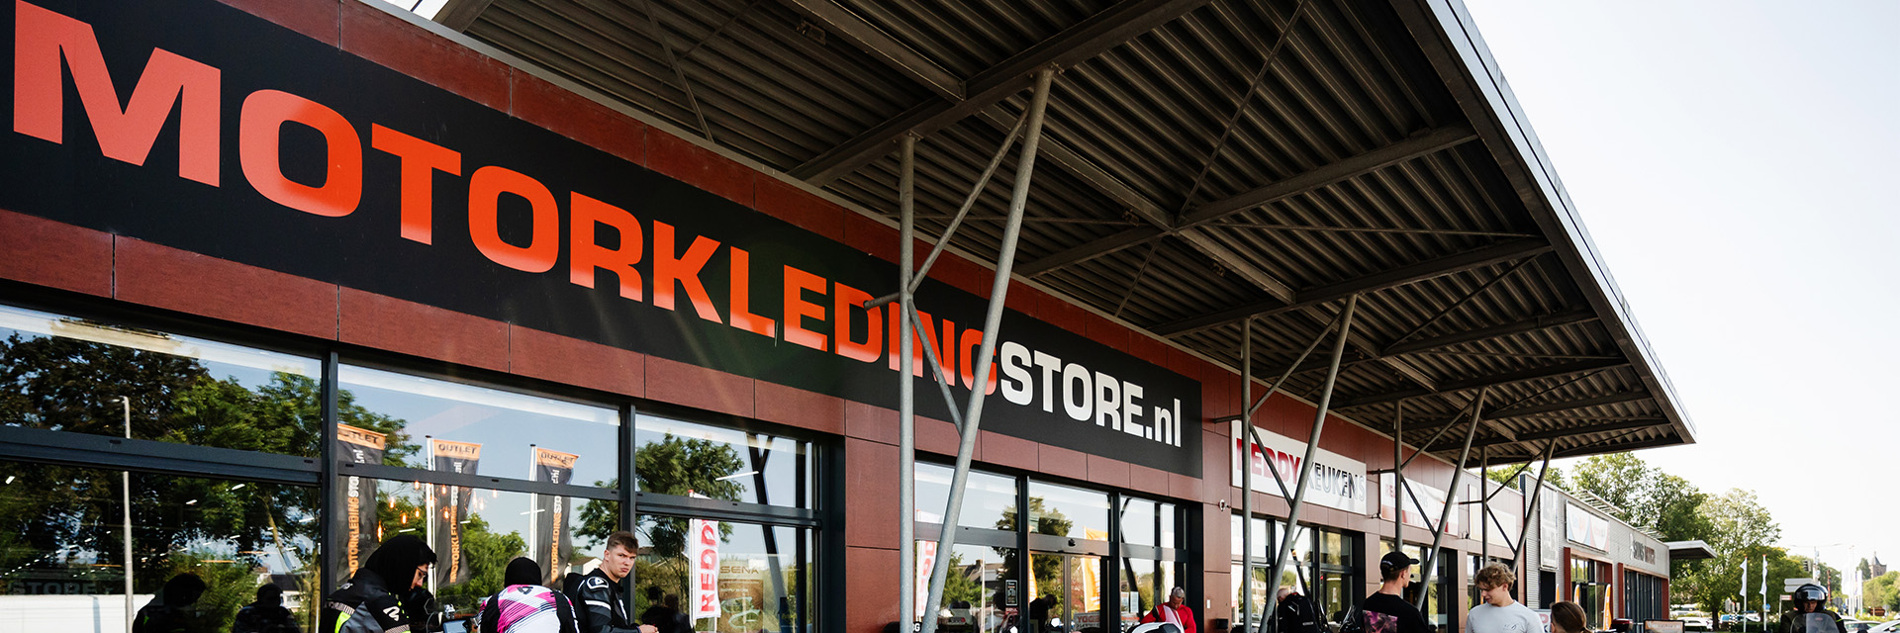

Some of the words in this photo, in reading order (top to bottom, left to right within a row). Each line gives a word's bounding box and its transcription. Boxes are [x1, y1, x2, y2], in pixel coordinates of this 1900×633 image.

[13, 0, 1182, 447] MOTORKLEDINGSTORE.nl
[438, 443, 477, 455] OUTLET
[700, 519, 718, 612] REDD
[719, 565, 759, 574] SENA
